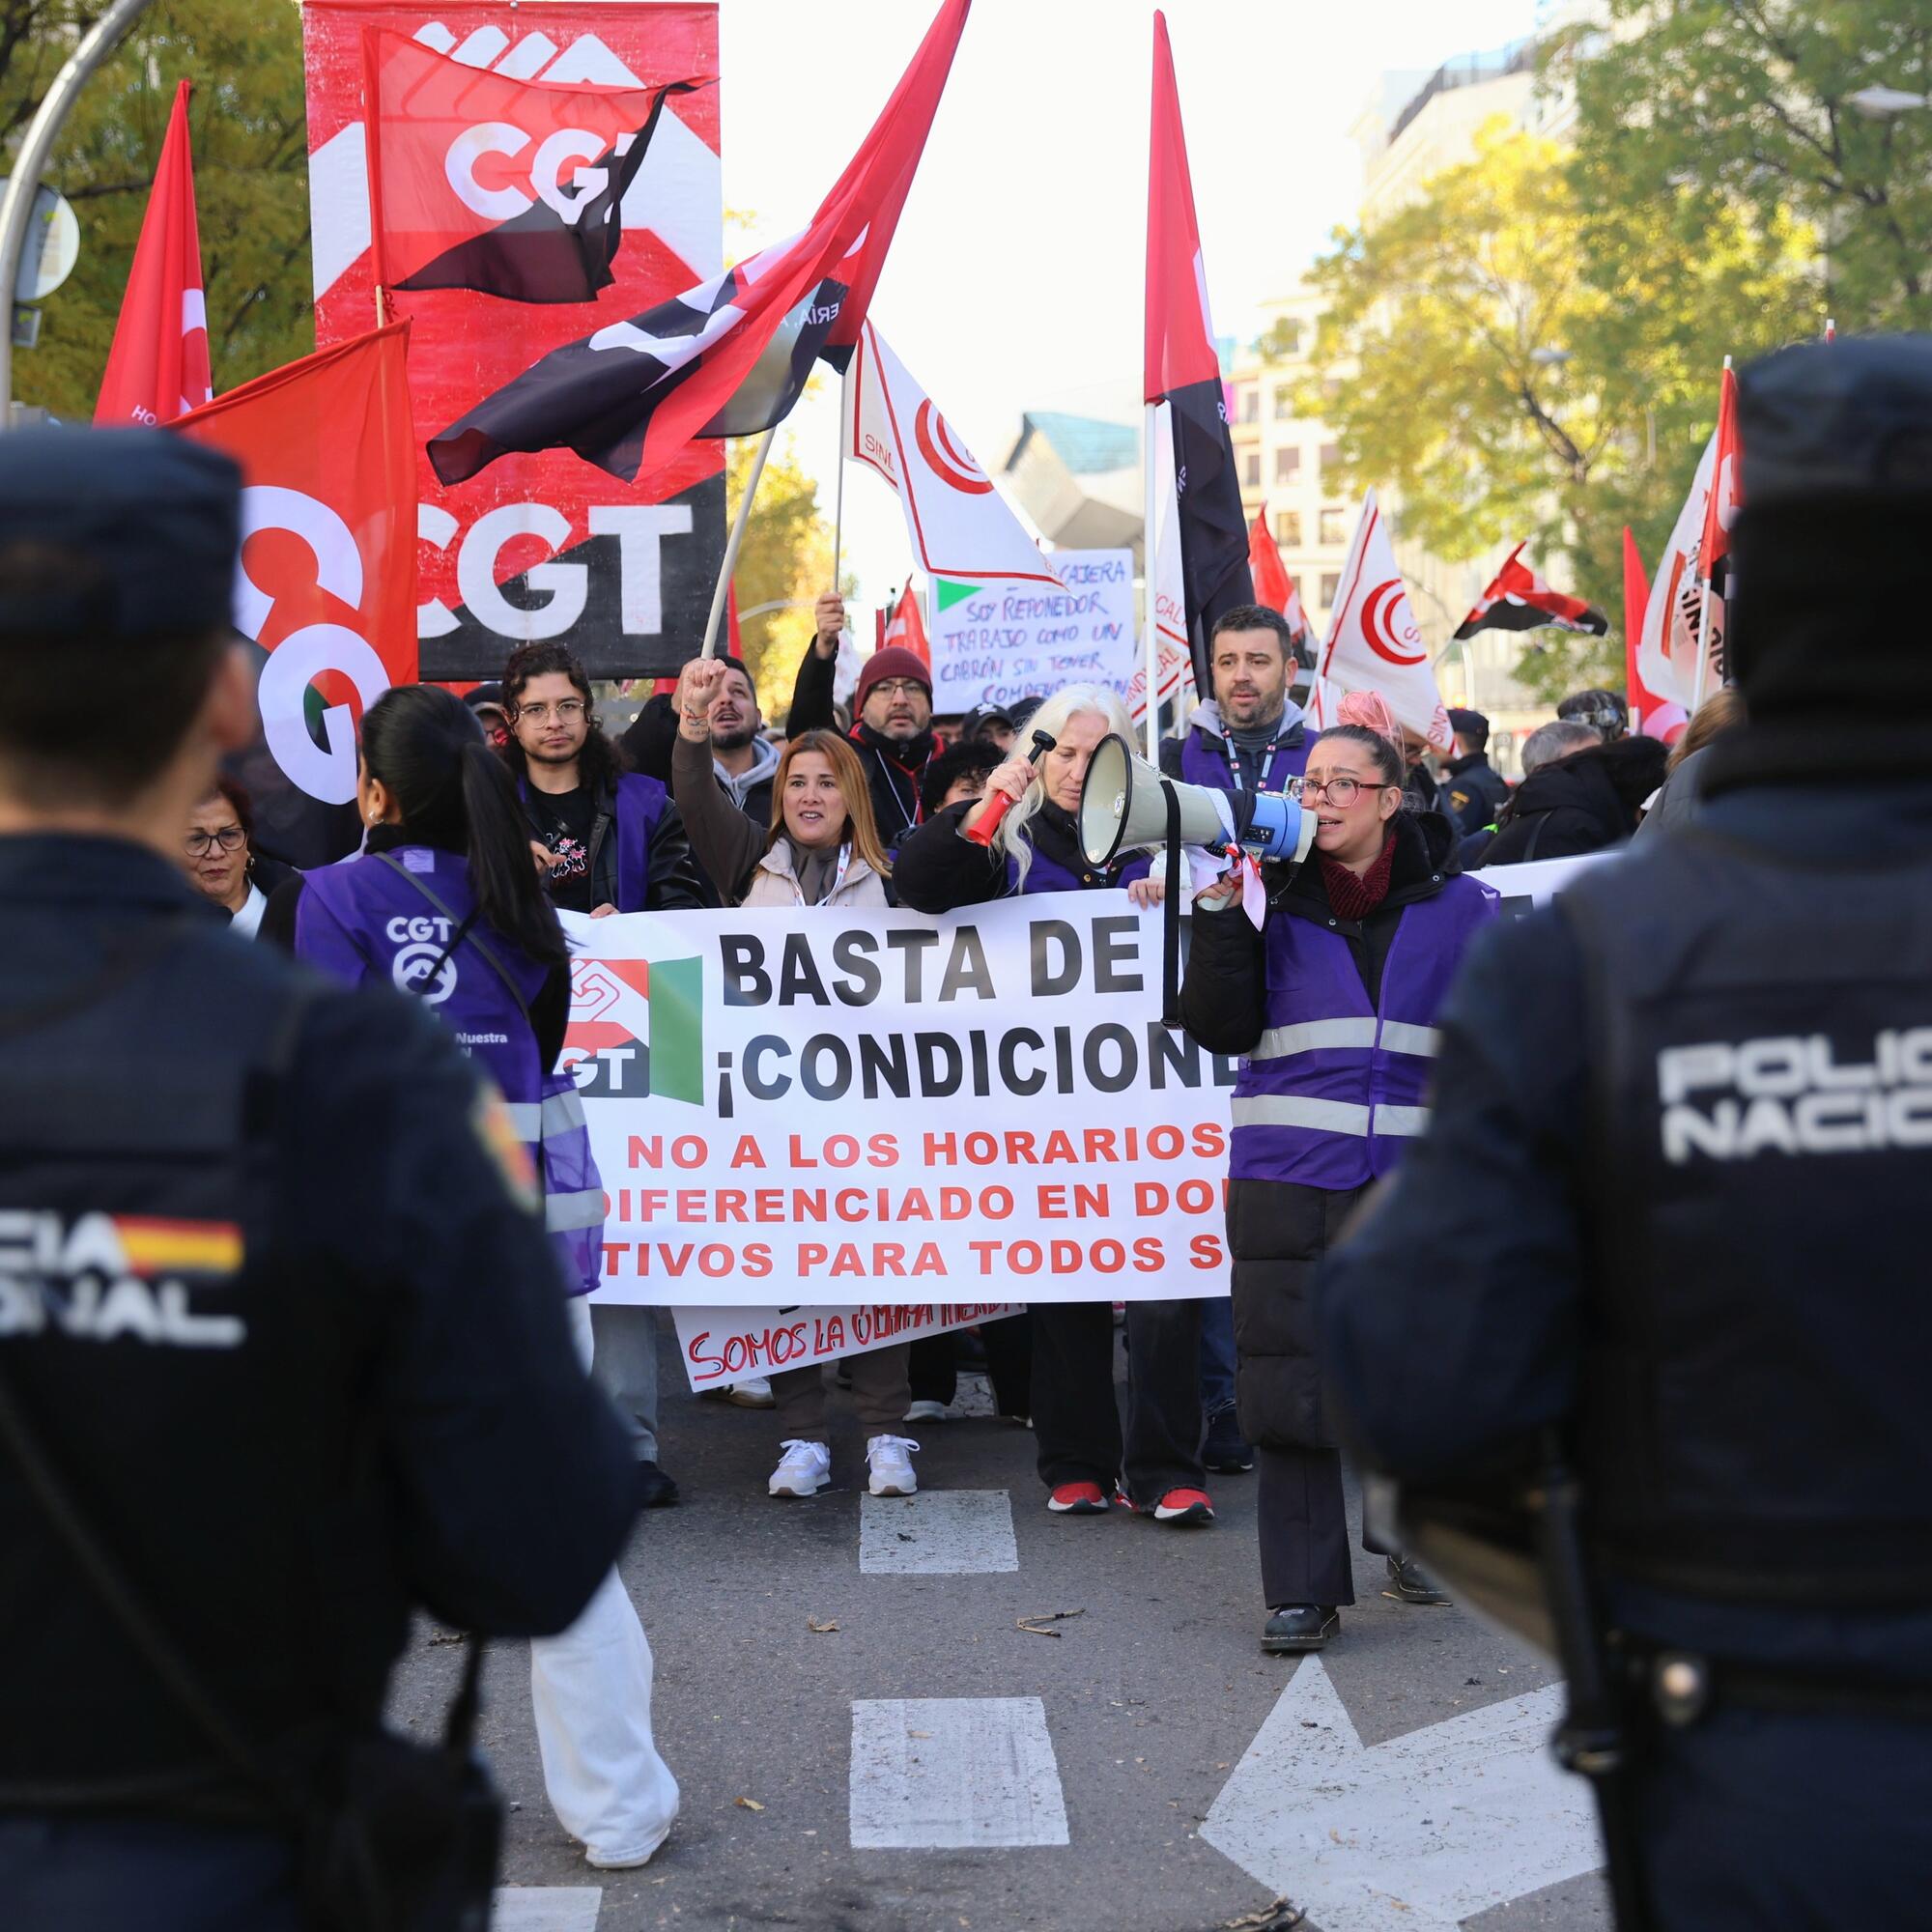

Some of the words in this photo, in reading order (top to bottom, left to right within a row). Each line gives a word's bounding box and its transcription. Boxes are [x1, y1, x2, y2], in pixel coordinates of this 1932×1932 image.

[967, 602, 998, 623] SOY
[1002, 591, 1109, 621] REPONEDOR
[944, 629, 1028, 654] TRABAJO
[1037, 626, 1079, 646] COMO
[1092, 622, 1123, 641] UN
[1012, 659, 1039, 676] SIN
[386, 917, 454, 943] CGT
[720, 924, 996, 1007] BASTA
[1029, 915, 1144, 998] DE
[456, 1033, 508, 1044] Nuestra
[628, 1134, 709, 1169] NO
[730, 1134, 766, 1168] A
[789, 1133, 899, 1168] LOS
[923, 1122, 1225, 1166] HORARIOS
[1037, 1183, 1110, 1219] EN
[798, 1241, 949, 1277] PARA
[969, 1237, 1165, 1275] TODOS
[689, 1321, 807, 1381] SOMOS
[813, 1315, 845, 1355] LA
